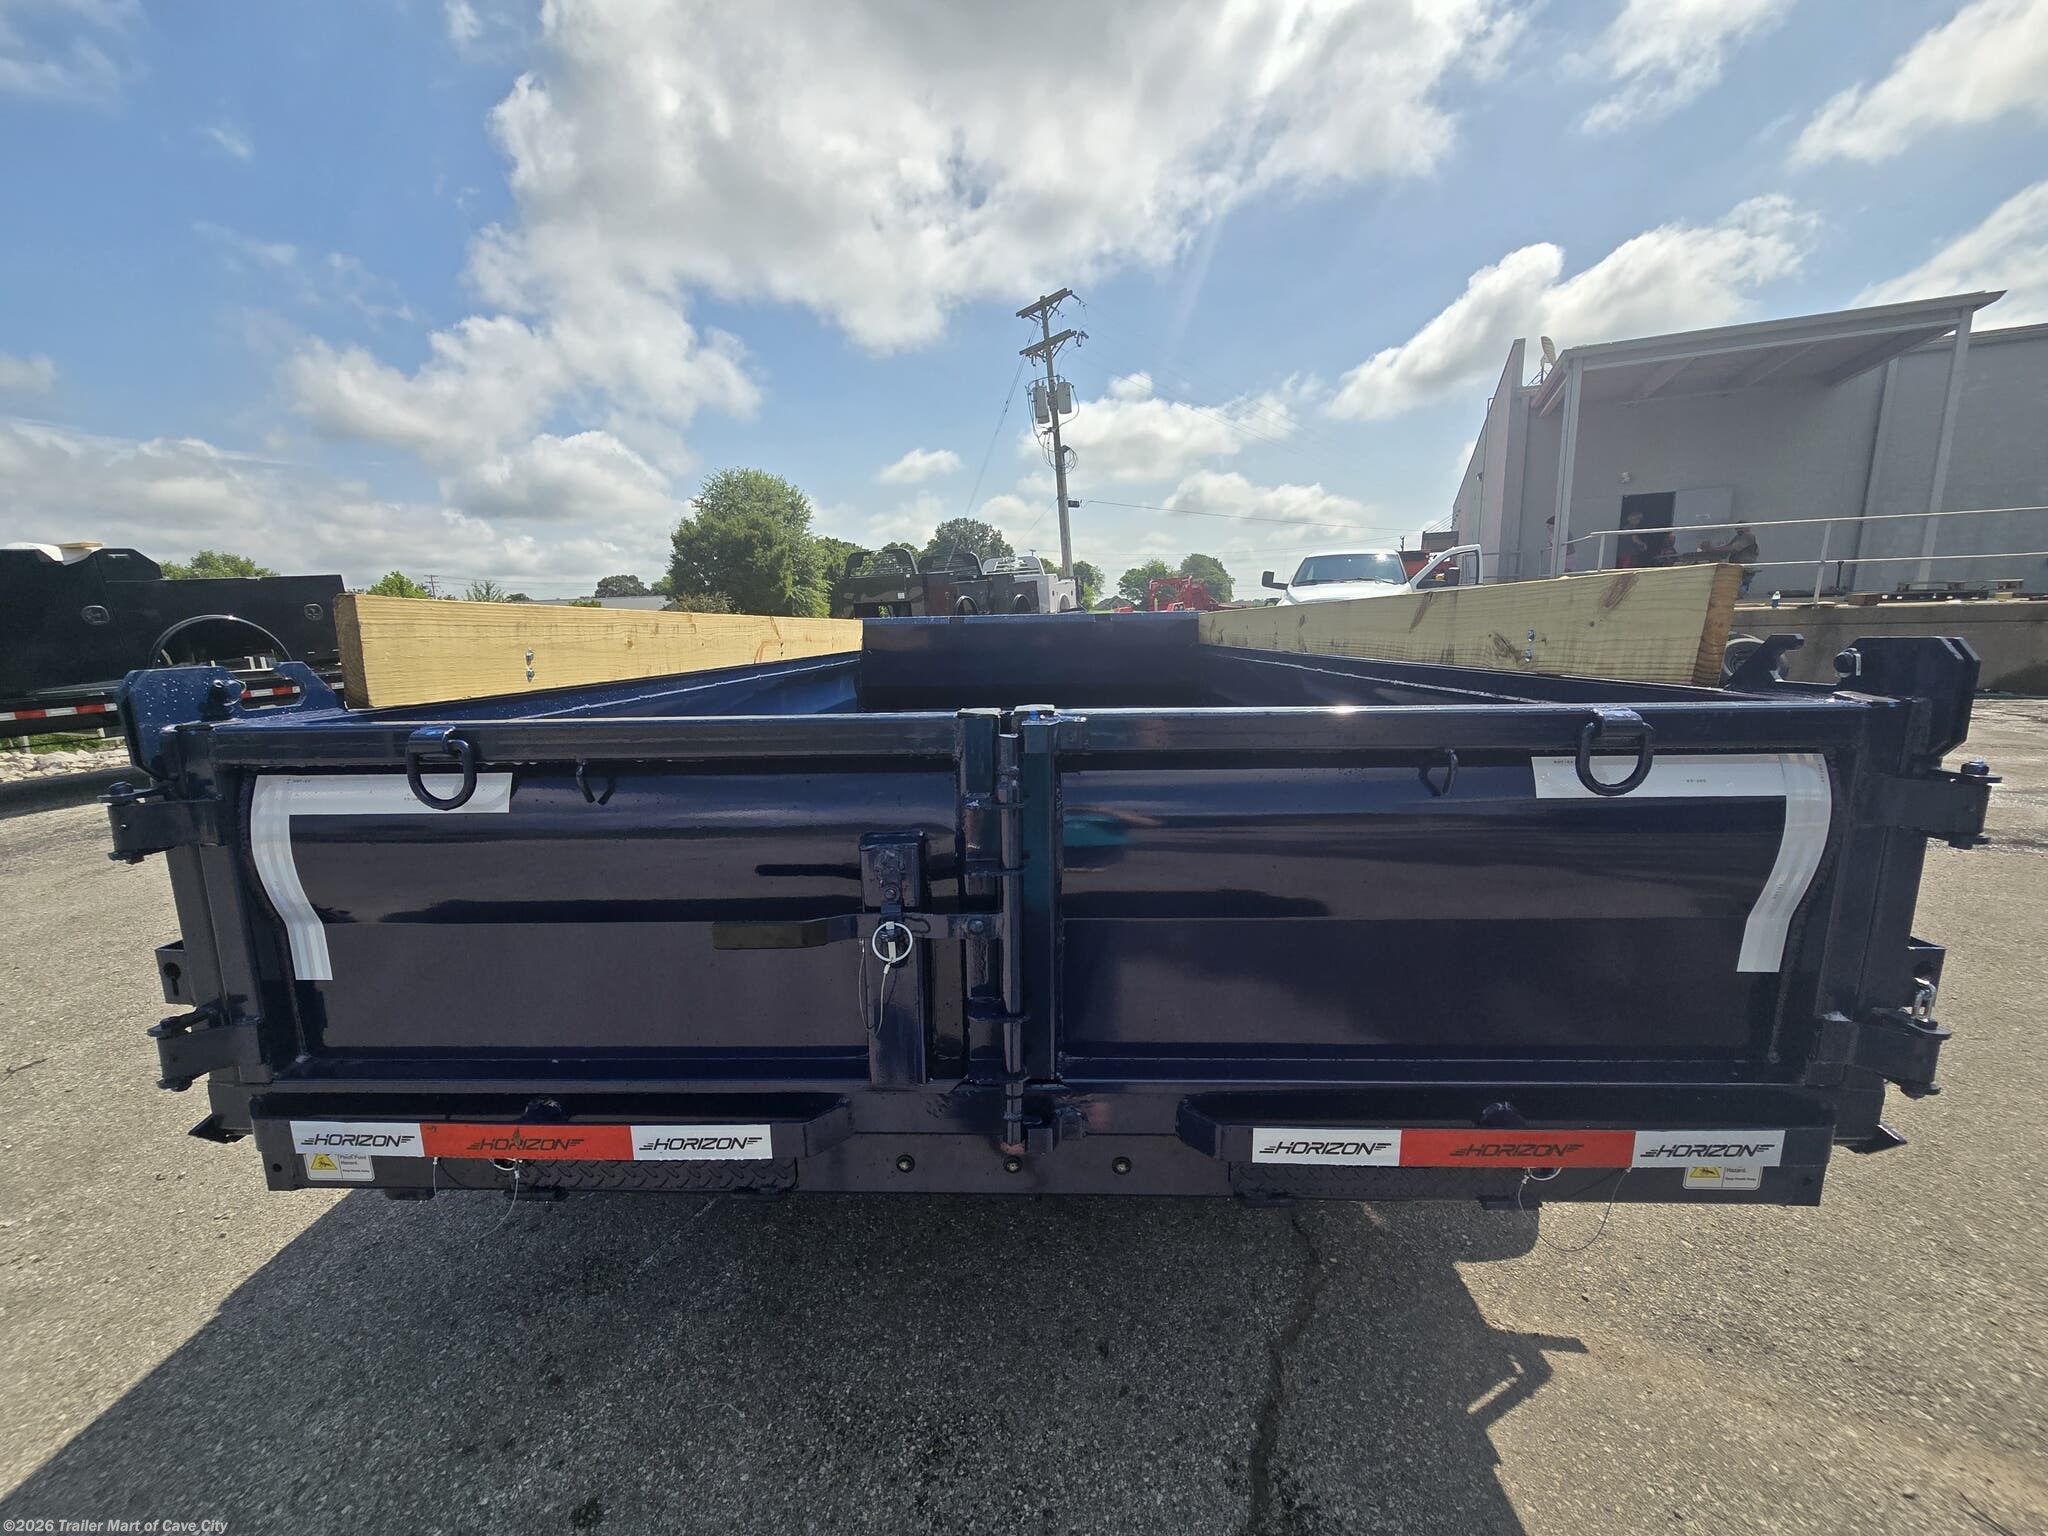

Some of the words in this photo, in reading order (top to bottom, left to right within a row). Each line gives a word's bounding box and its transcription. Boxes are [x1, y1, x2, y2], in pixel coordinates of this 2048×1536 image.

[312, 1133, 402, 1148] HORIZON
[652, 1137, 750, 1151] HORIZON
[1274, 1141, 1377, 1156] HORIZON
[1465, 1143, 1568, 1157] HORIZON
[1655, 1144, 1760, 1158] HORIZON
